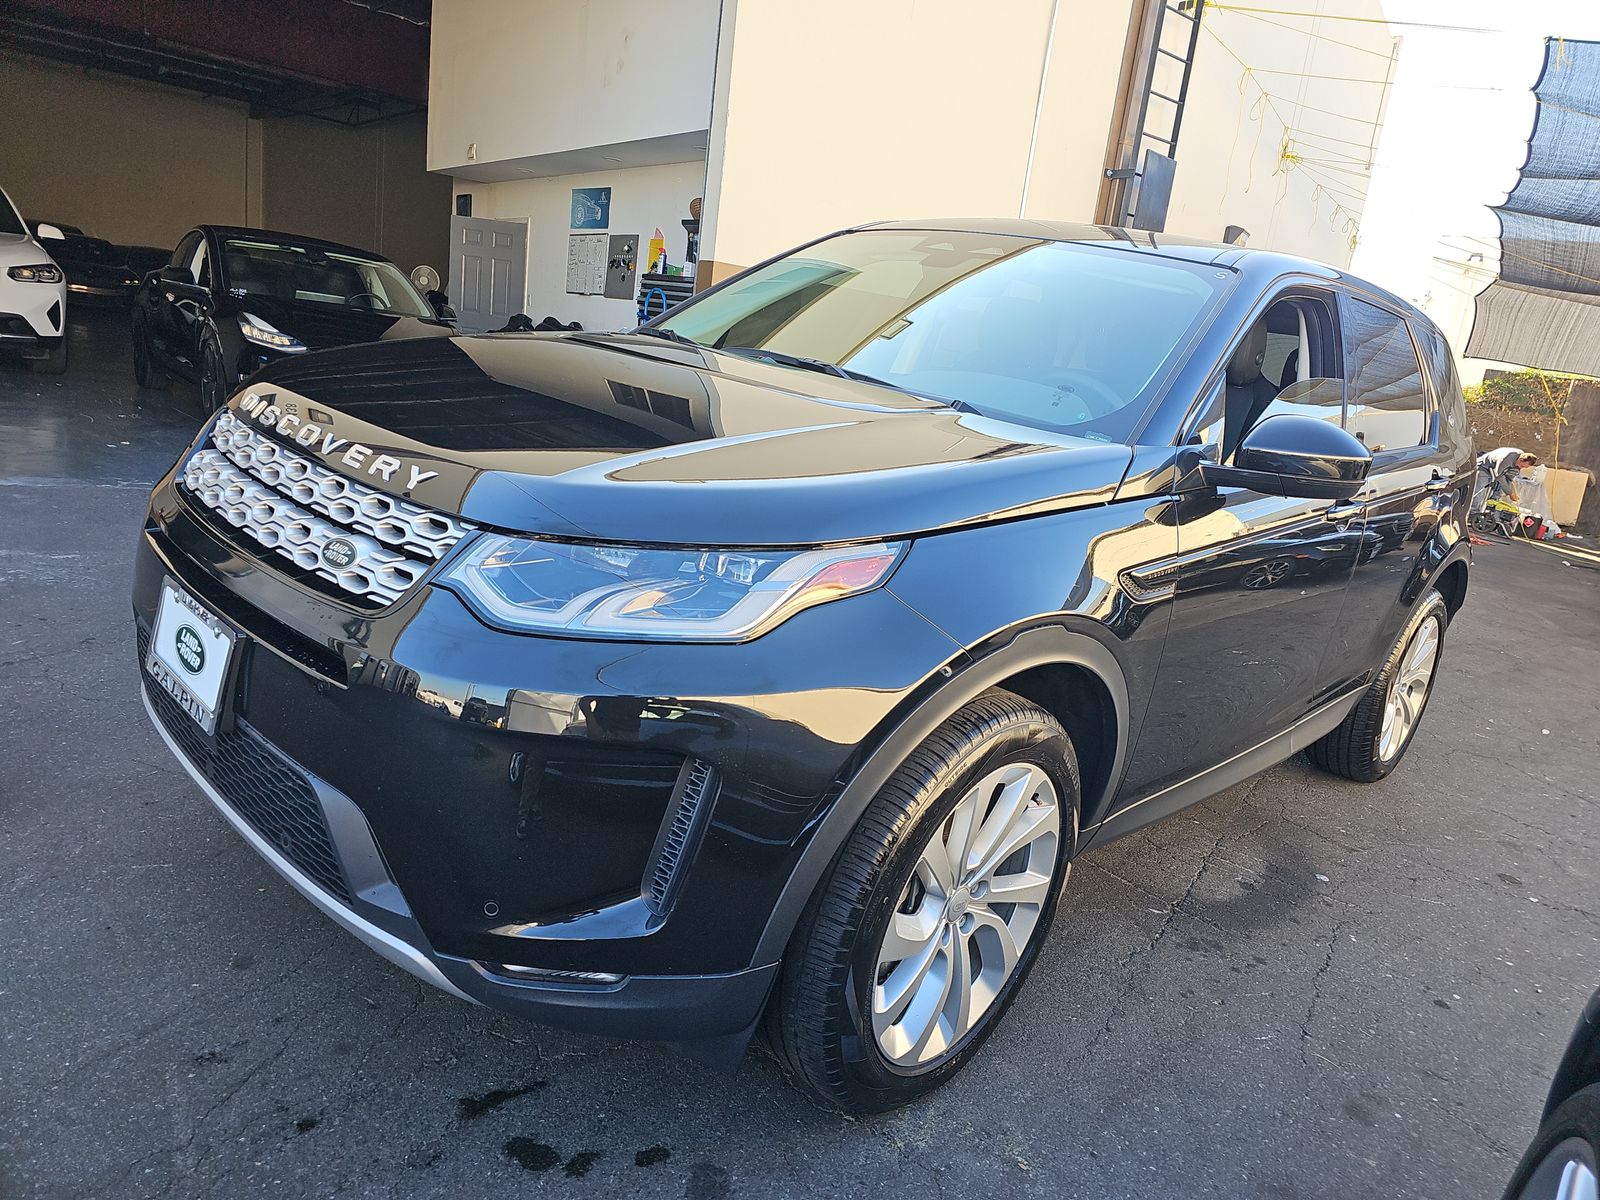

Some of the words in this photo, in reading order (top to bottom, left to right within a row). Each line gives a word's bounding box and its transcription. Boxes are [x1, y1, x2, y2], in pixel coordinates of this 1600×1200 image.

[239, 393, 440, 490] DISCOVERY
[325, 550, 349, 566] ROVER
[329, 541, 349, 555] LAND
[180, 628, 199, 652] LAND
[179, 642, 201, 670] ROVER
[152, 661, 205, 724] GALPIN
